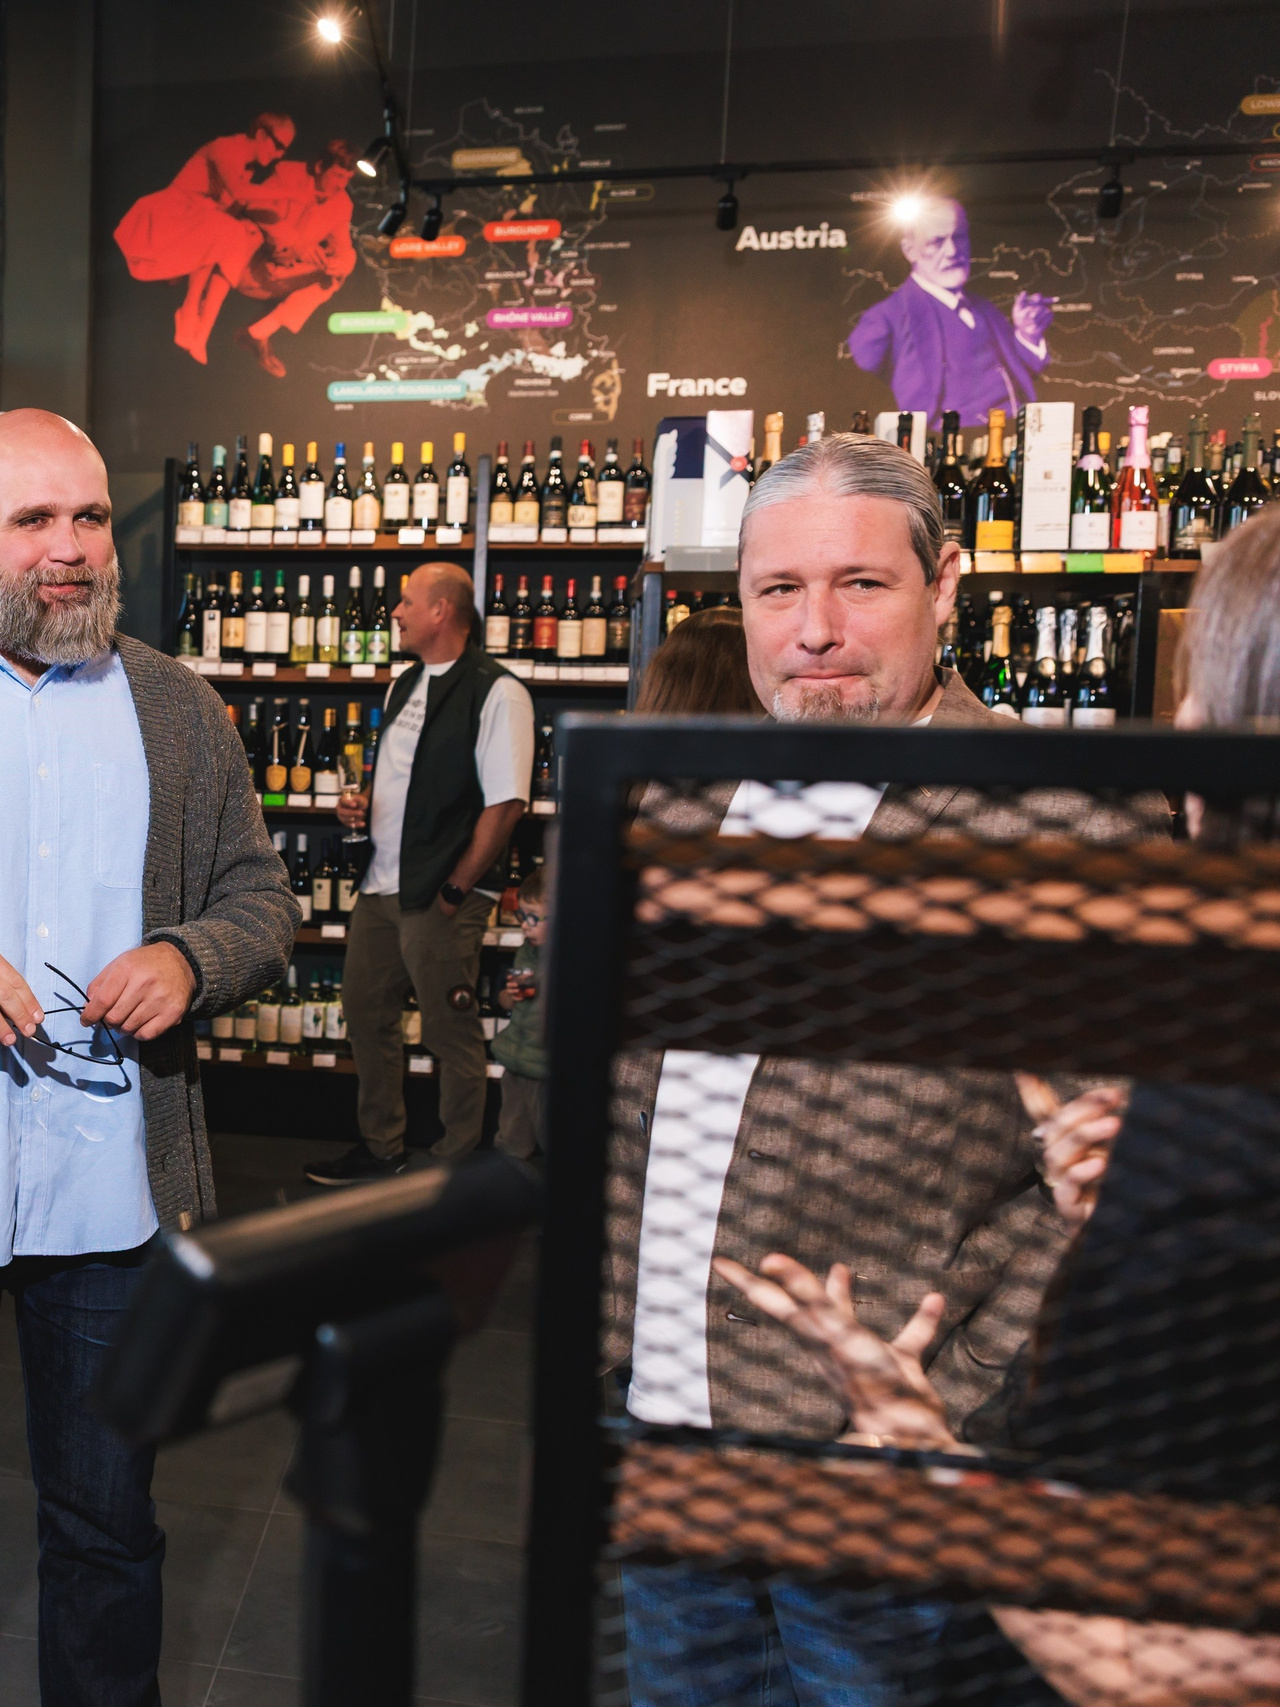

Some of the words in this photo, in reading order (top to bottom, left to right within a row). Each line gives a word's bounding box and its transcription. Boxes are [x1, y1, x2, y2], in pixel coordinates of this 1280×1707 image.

[493, 224, 551, 237] BURGUNDY
[735, 221, 849, 252] Austria
[394, 242, 422, 254] LOIRE
[424, 240, 461, 252] VALLEY
[340, 317, 396, 328] BORDEAUX
[492, 310, 530, 324] RHÔNE
[531, 311, 569, 323] VALLEY
[1219, 362, 1261, 375] STYRIA
[646, 372, 748, 398] France
[1253, 390, 1280, 402] SLO
